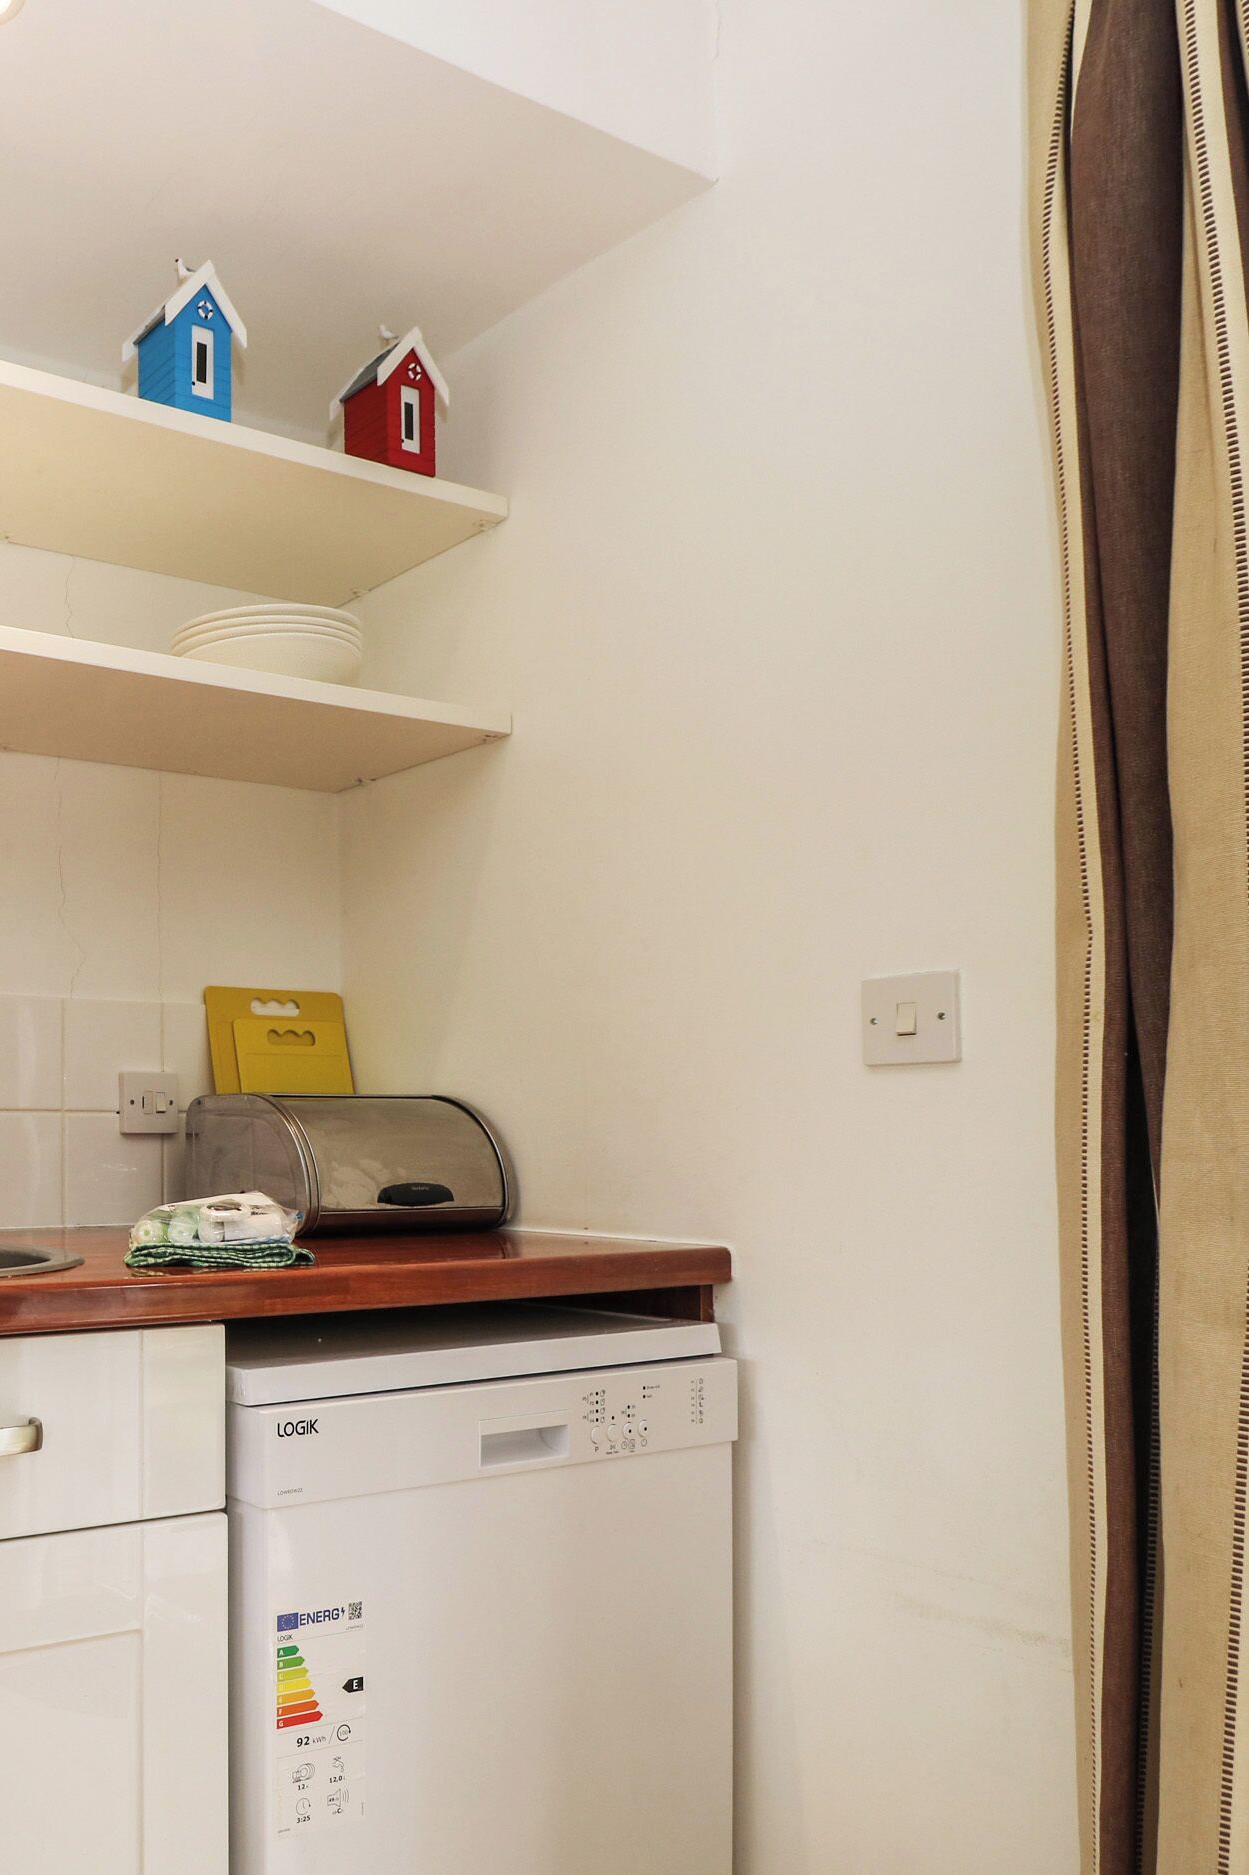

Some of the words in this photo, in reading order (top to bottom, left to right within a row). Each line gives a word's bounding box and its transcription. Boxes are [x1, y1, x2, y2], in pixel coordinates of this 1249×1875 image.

[277, 1418, 319, 1438] LOGIK
[277, 1634, 293, 1642] LOGIK
[353, 1679, 359, 1690] E
[296, 1736, 310, 1748] 92
[296, 1815, 311, 1824] 3:25
